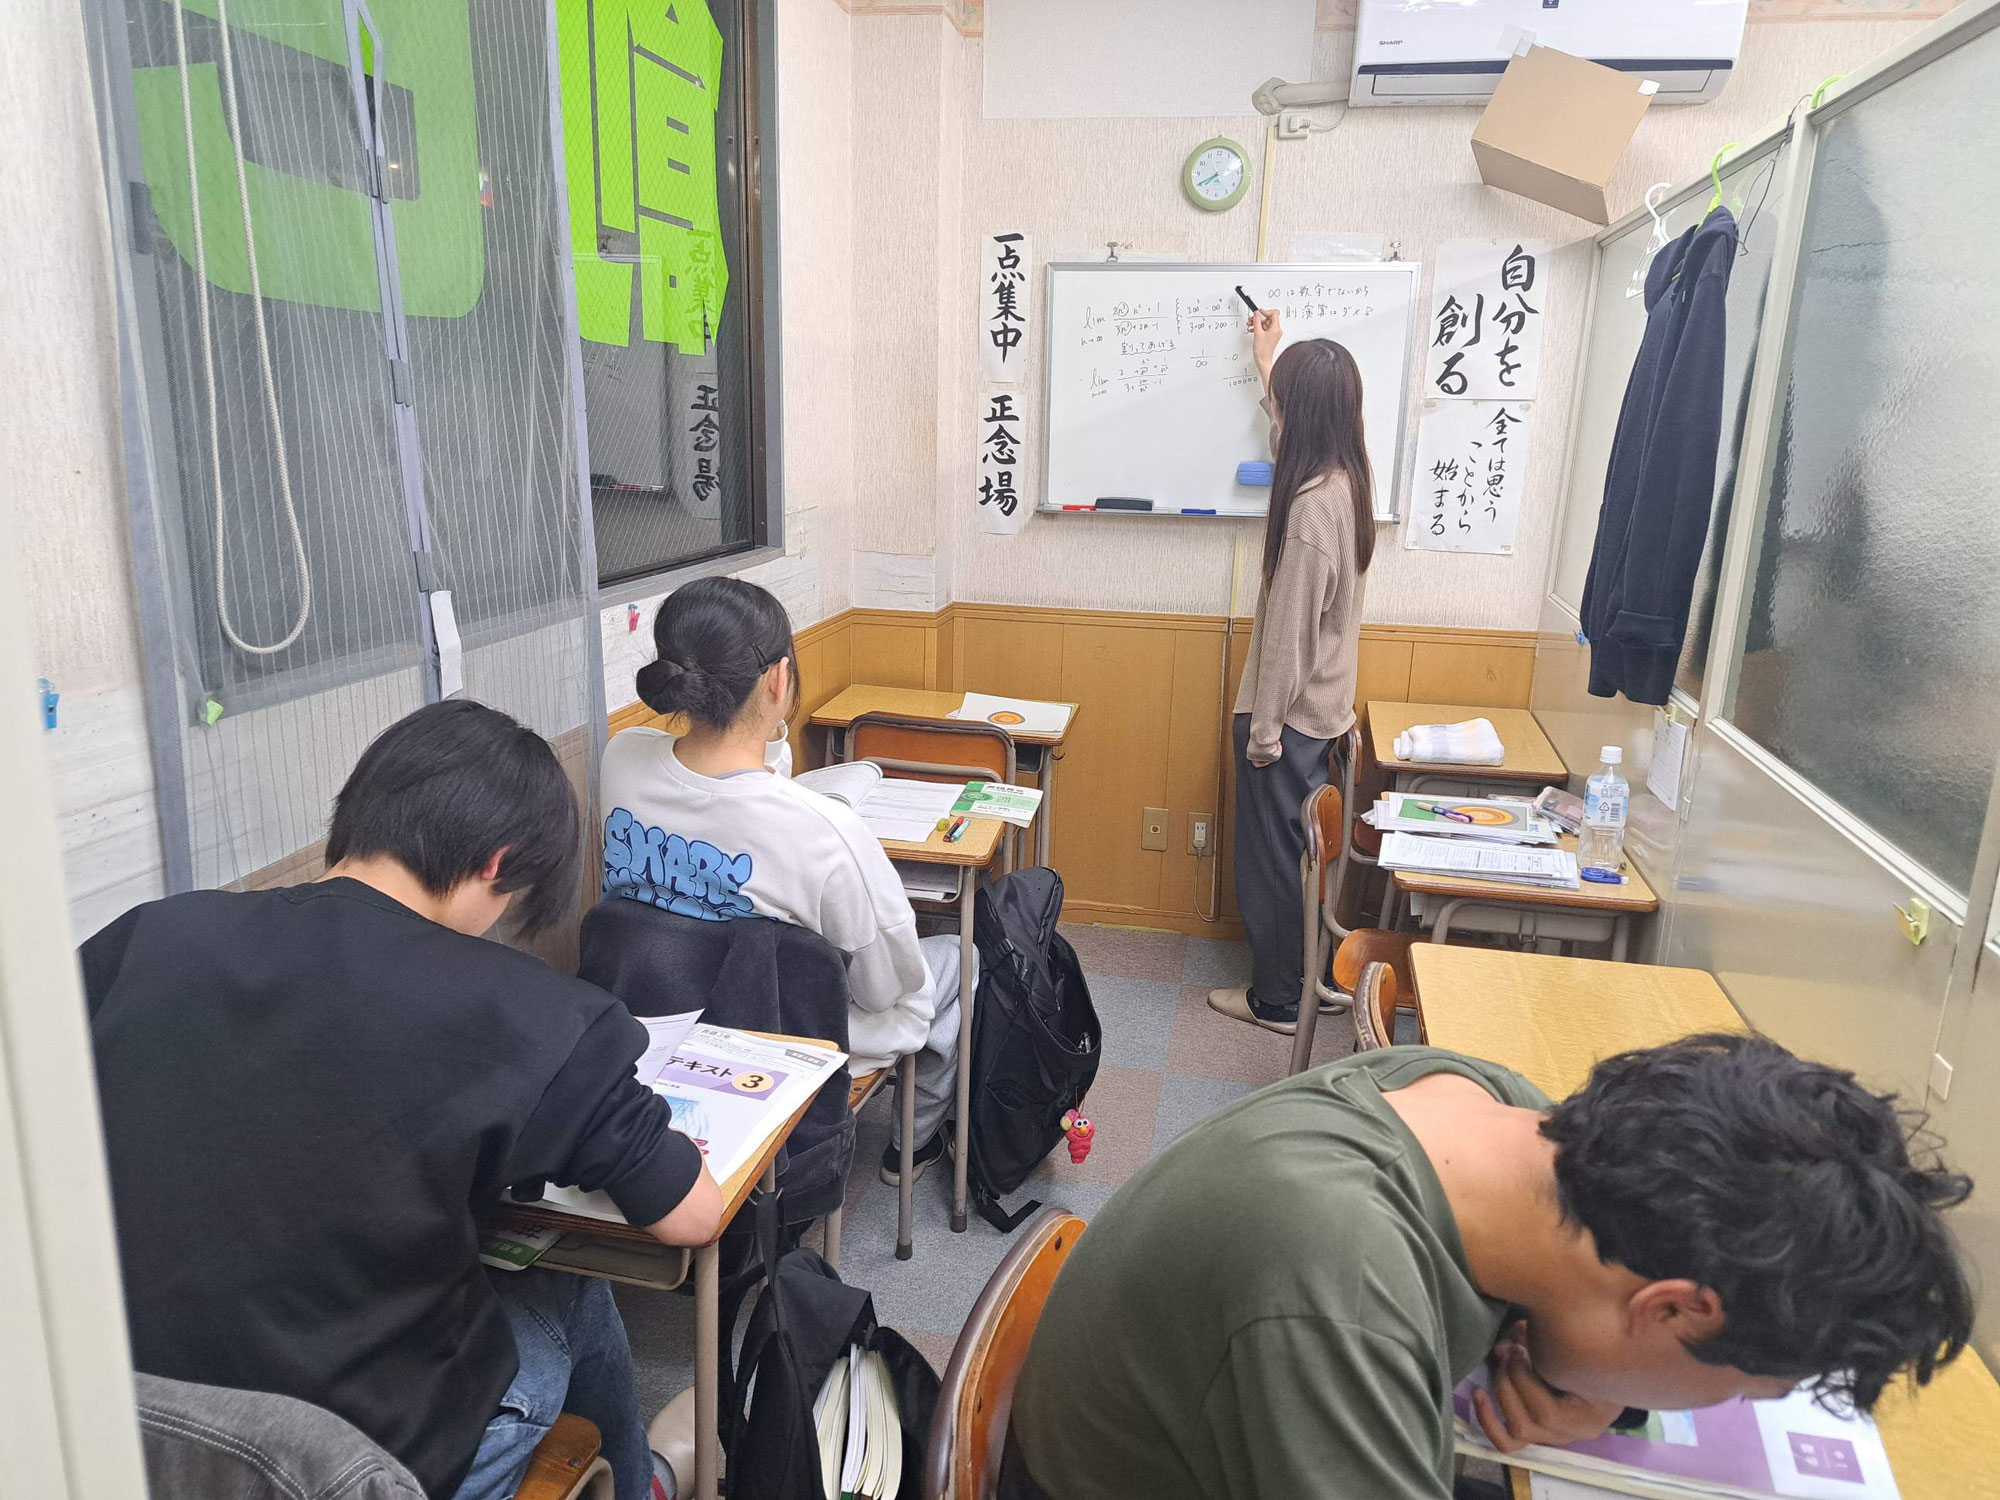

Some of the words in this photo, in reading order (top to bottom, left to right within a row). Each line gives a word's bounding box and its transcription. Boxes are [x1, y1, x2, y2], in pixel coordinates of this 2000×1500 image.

[990, 232, 1026, 364] 一点集中
[1432, 293, 1484, 396] 創る
[1491, 244, 1541, 387] 自分を
[978, 394, 1021, 517] 正念場
[1428, 457, 1459, 536] 始まる
[1456, 440, 1483, 535] ことから
[1482, 407, 1523, 523] 全ては思う
[666, 1056, 733, 1078] テキスト
[741, 1074, 765, 1090] 3
